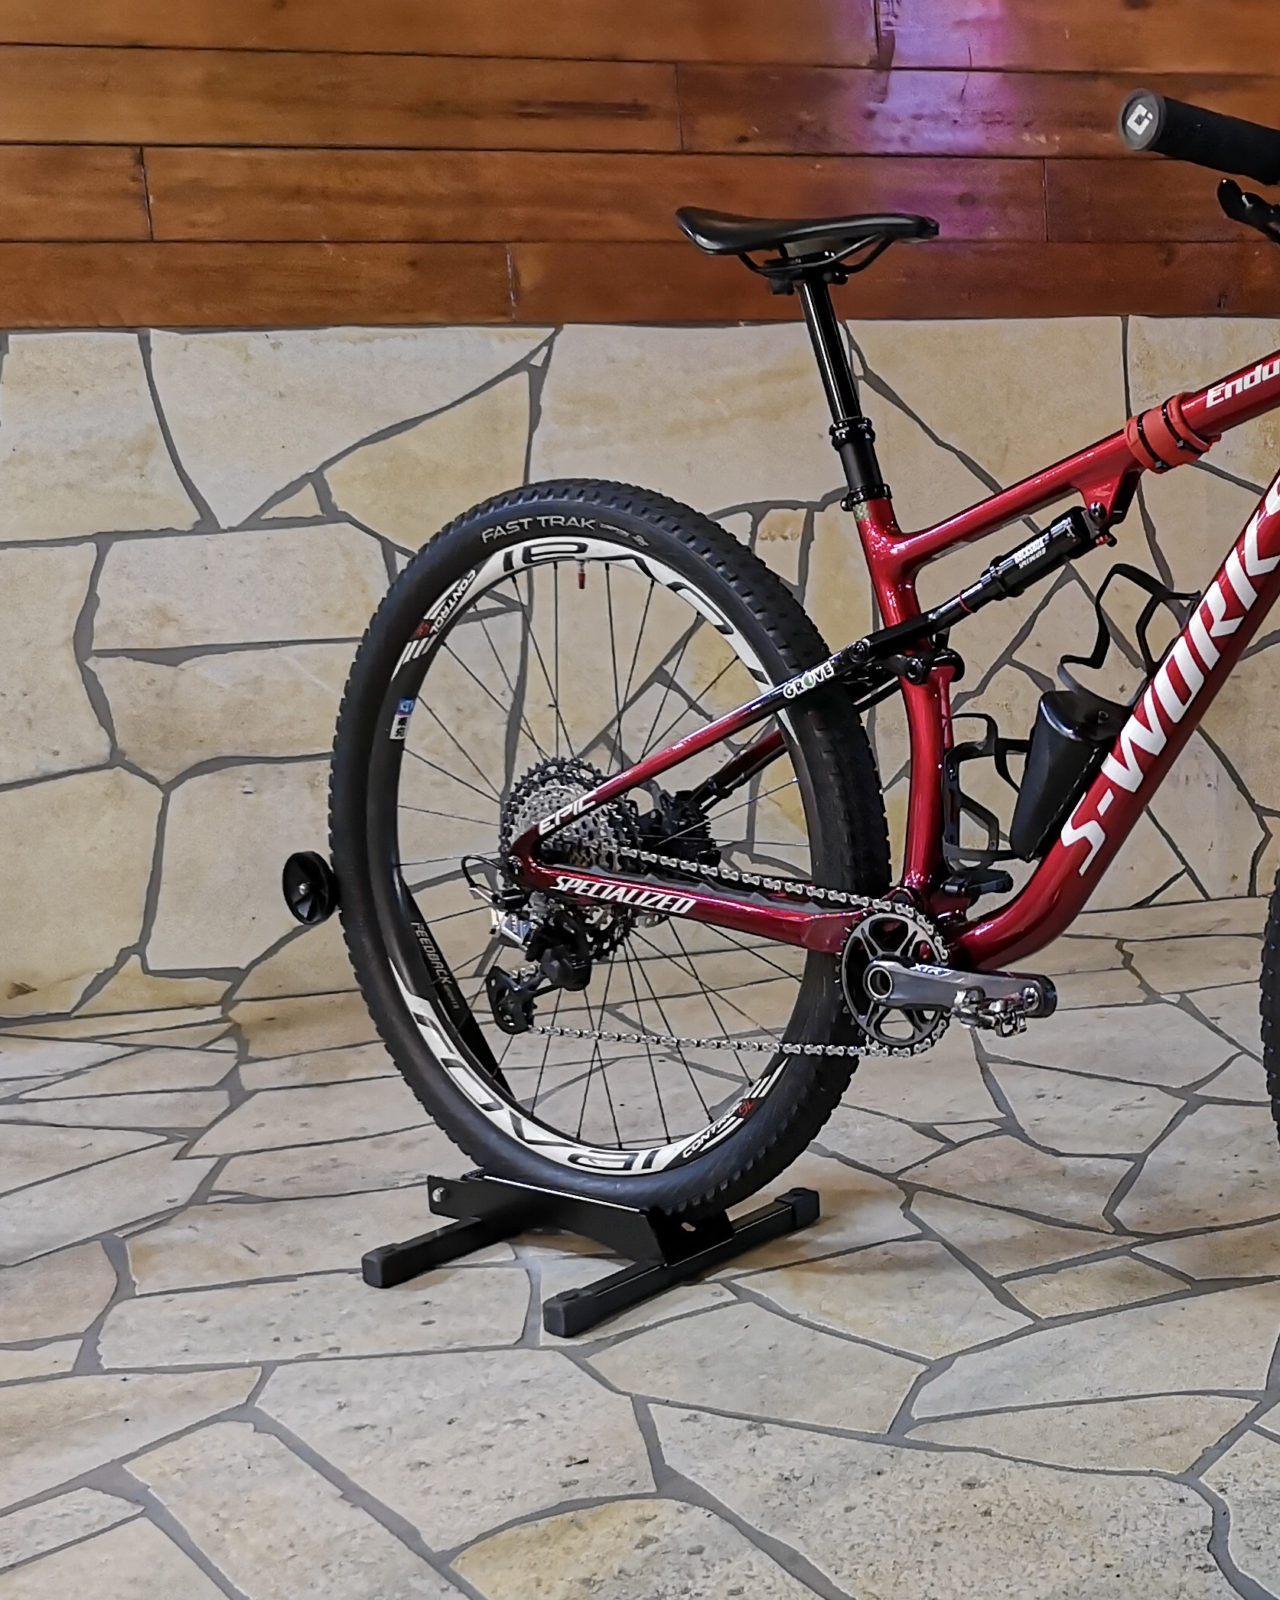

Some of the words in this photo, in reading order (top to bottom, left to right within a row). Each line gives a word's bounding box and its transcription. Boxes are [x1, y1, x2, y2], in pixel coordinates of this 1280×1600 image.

[482, 518, 533, 543] FAST
[536, 515, 597, 530] TRAK
[429, 569, 476, 634] CONTROL
[538, 790, 597, 835] EPIC
[549, 875, 697, 914] SPECIALIZED
